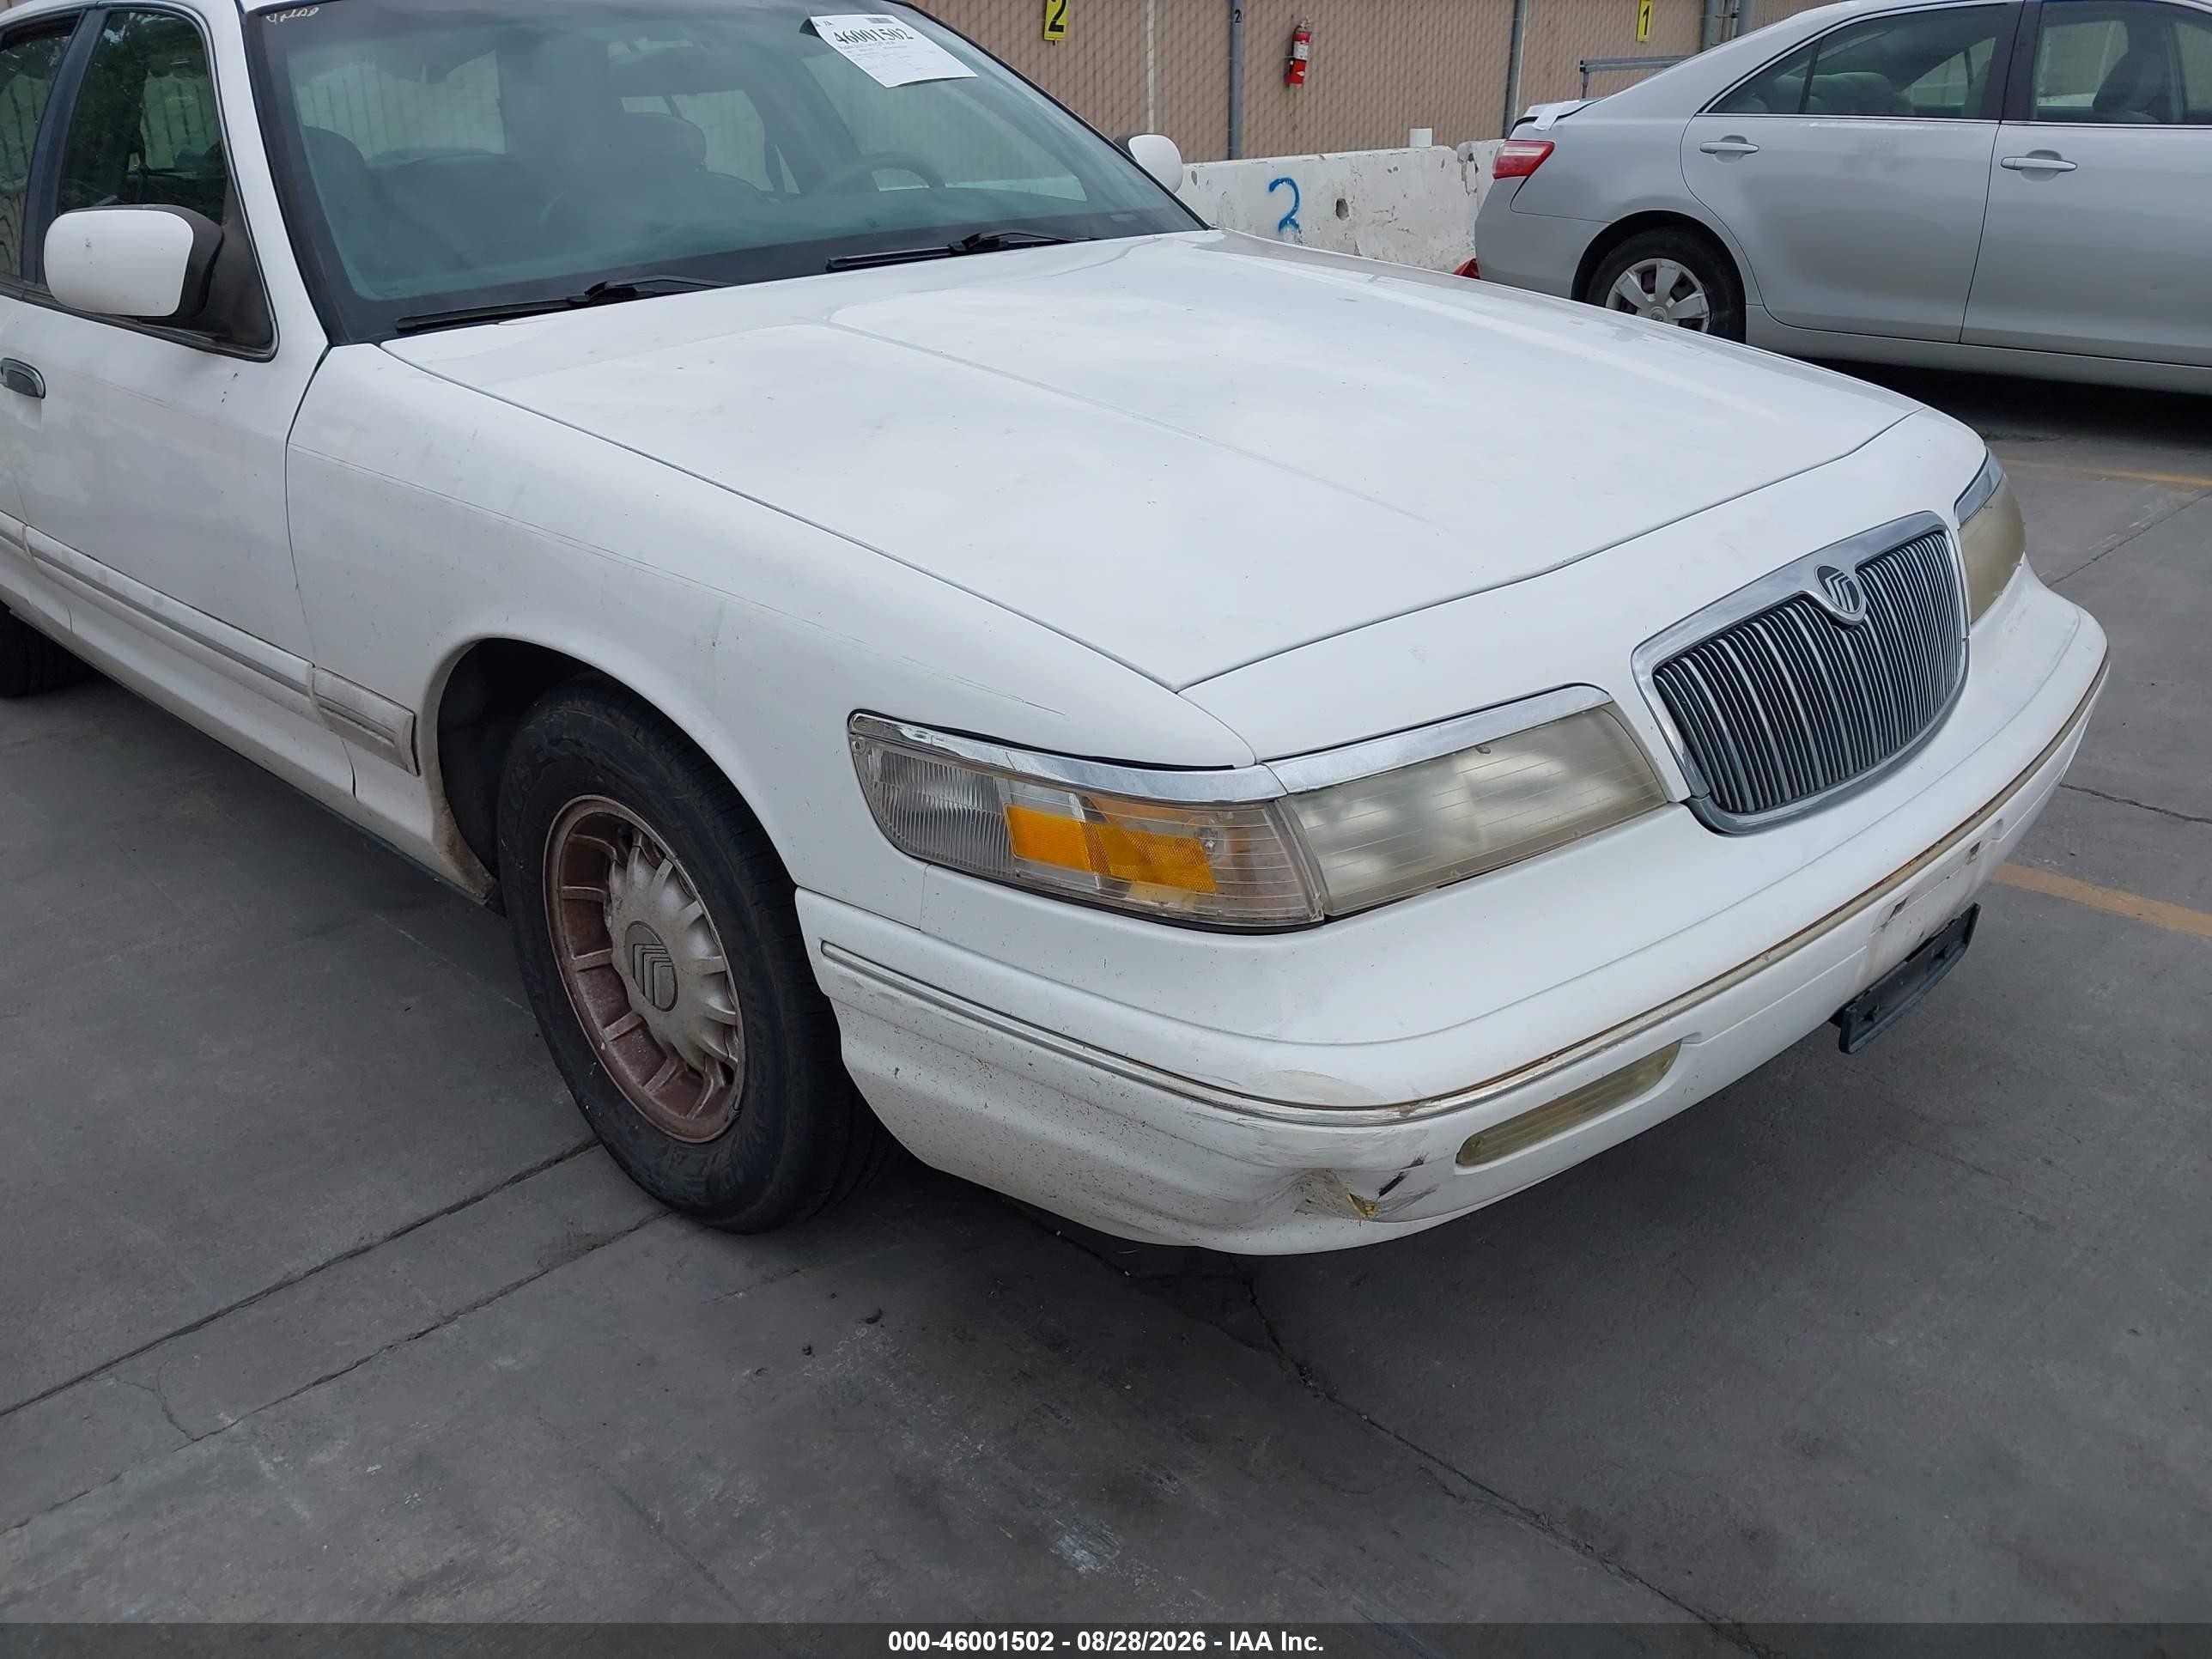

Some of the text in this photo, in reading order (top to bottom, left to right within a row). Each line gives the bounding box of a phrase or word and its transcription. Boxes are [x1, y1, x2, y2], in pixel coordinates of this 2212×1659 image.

[1048, 0, 1066, 33] 2
[1643, 5, 1650, 35] 1
[833, 27, 914, 45] 46001502
[1268, 177, 1300, 234] 2
